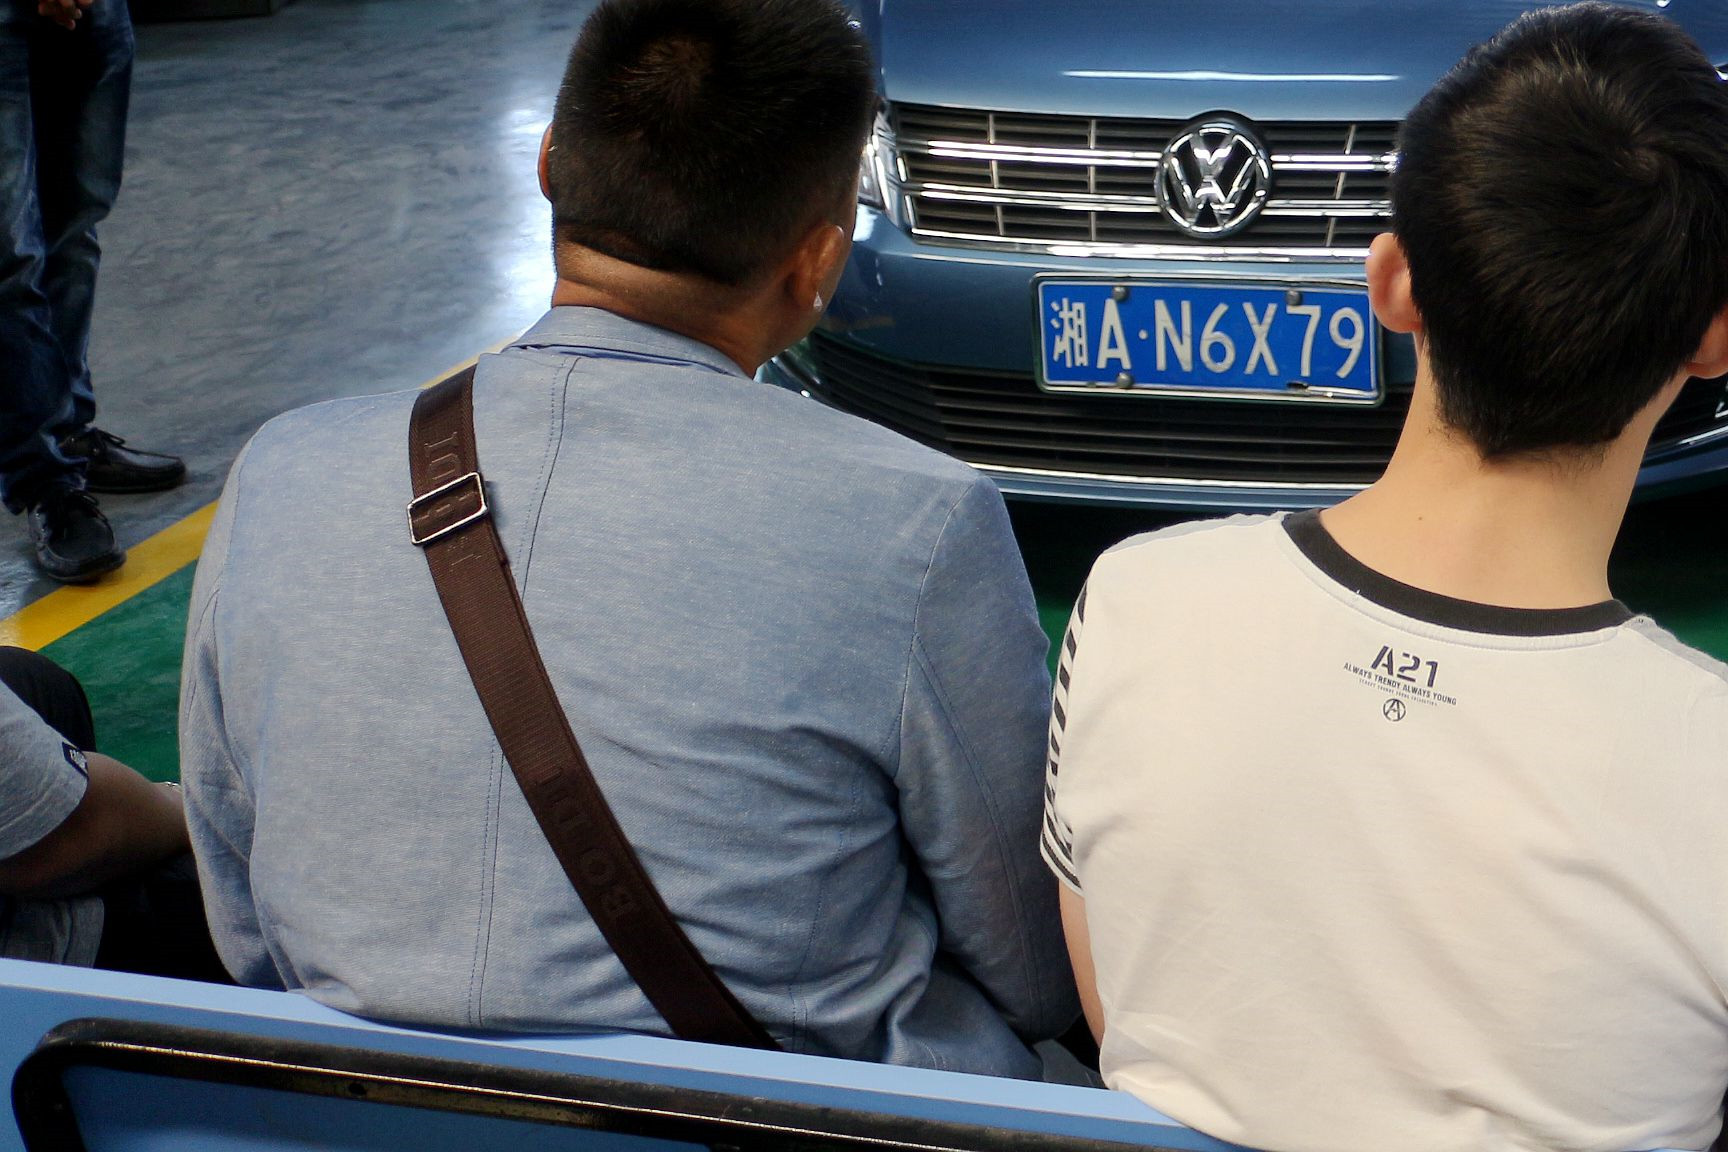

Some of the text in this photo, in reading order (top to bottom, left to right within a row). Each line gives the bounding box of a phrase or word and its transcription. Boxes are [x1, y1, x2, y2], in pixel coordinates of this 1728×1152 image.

[1343, 662, 1373, 680] ALWAYS
[1374, 673, 1401, 689] TRENDY
[1402, 683, 1431, 699] ALWAYS
[1433, 692, 1457, 706] YOUNG
[1370, 645, 1439, 688] A21
